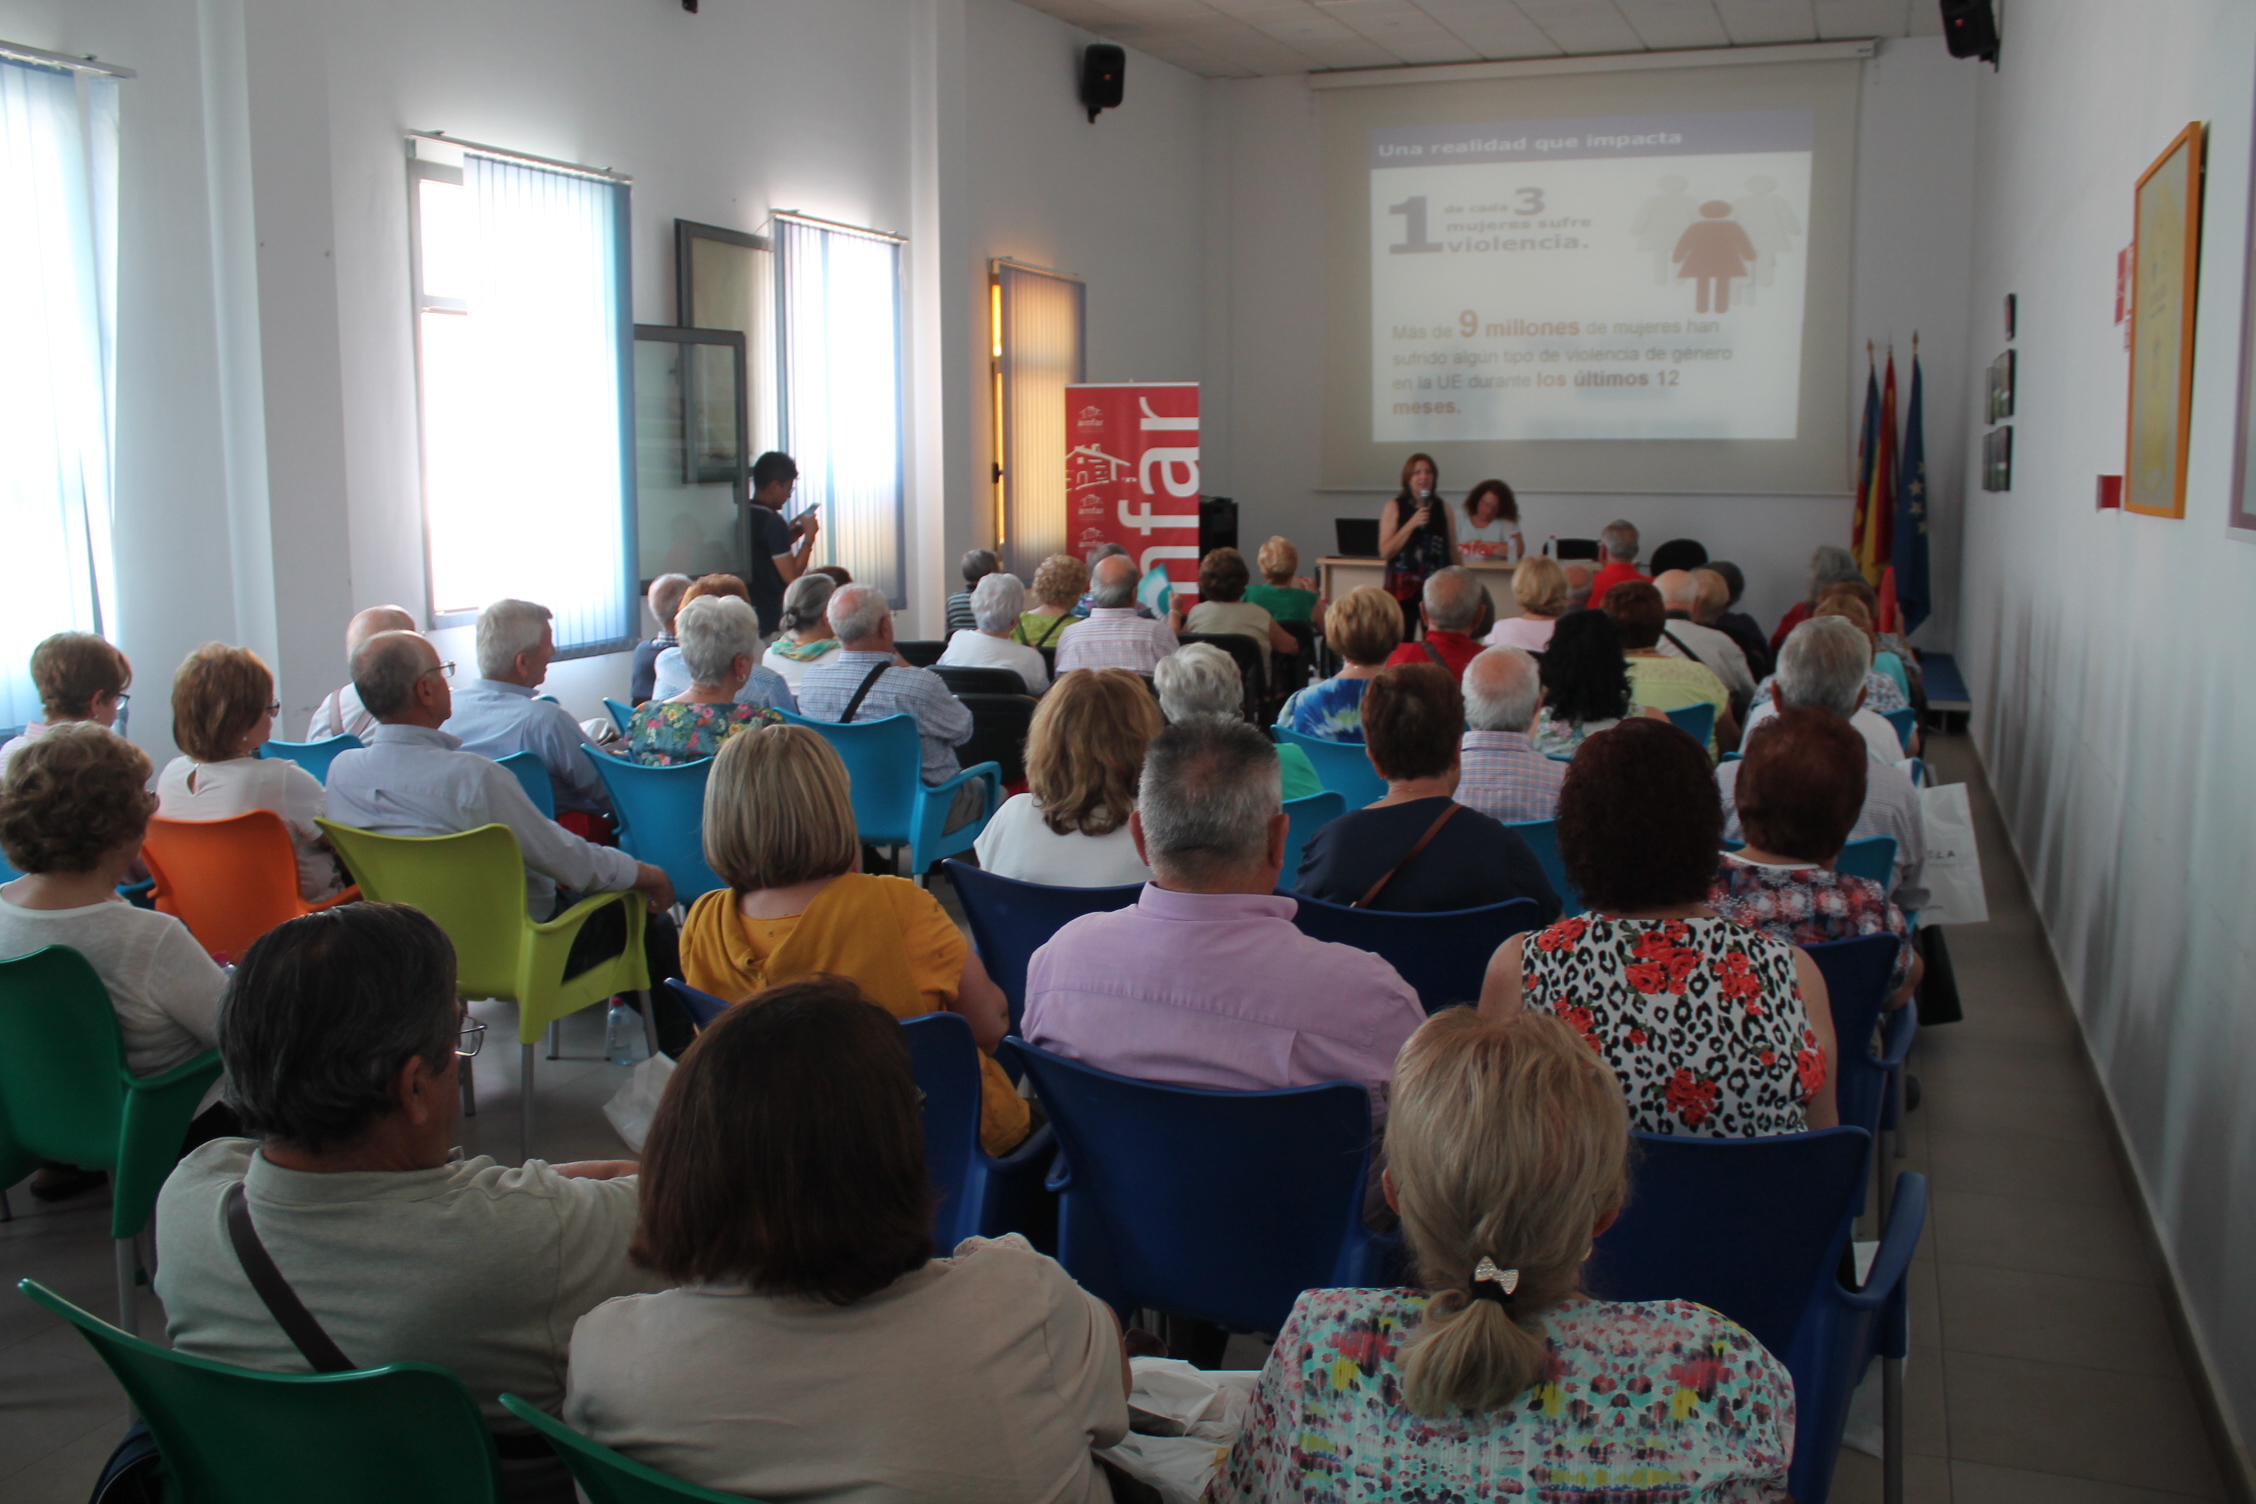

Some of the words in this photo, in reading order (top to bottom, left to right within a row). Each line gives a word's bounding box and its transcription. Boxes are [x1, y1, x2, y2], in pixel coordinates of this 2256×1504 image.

[1378, 144, 1423, 158] Una
[1431, 137, 1527, 154] realidad
[1534, 136, 1579, 152] que
[1586, 132, 1682, 149] impacta
[1444, 204, 1464, 214] de
[1468, 202, 1509, 213] cada
[1513, 186, 1546, 216] 3
[1388, 195, 1444, 254] 1
[1446, 219, 1532, 233] mujeres
[1537, 216, 1593, 228] sufre
[1446, 234, 1589, 252] violencia.
[1392, 324, 1426, 339] Más
[1432, 324, 1453, 338] de
[1458, 309, 1479, 338] 9
[1486, 318, 1580, 337] millones
[1586, 320, 1607, 334] de
[1612, 320, 1682, 338] mujeres
[1686, 318, 1720, 334] han
[1392, 351, 1447, 366] sufrido
[1503, 350, 1534, 366] tipo
[1539, 348, 1560, 362] de
[1565, 347, 1640, 362] violencia
[1645, 346, 1666, 361] de
[1672, 346, 1733, 364] género
[1392, 378, 1413, 390] en
[1418, 376, 1433, 389] la
[1438, 374, 1462, 389] UE
[1468, 373, 1531, 389] durante
[1536, 371, 1567, 387] los
[1574, 370, 1649, 387] últimos
[1656, 369, 1680, 386] 12
[1392, 401, 1462, 415] meses.
